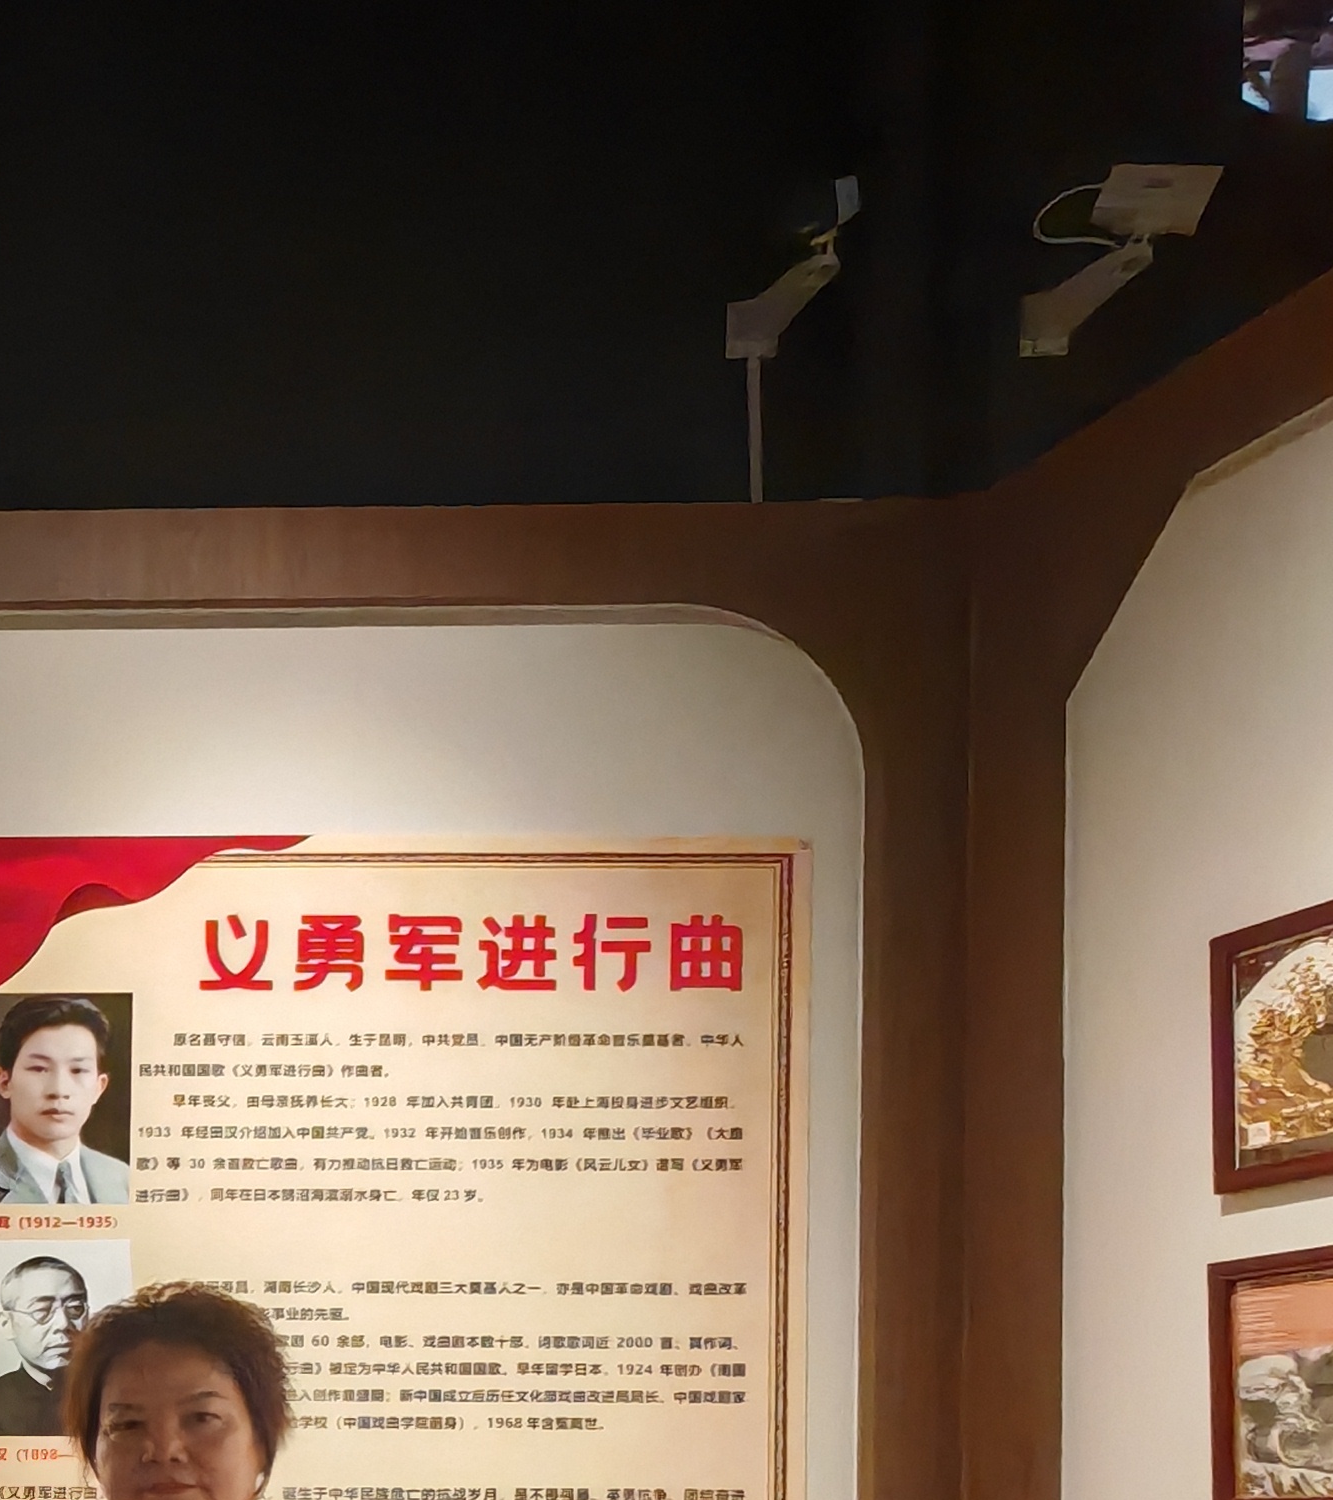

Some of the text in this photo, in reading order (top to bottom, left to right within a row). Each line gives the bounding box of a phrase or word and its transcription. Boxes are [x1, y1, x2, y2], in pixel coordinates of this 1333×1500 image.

[199, 913, 744, 992] 义勇军进行曲
